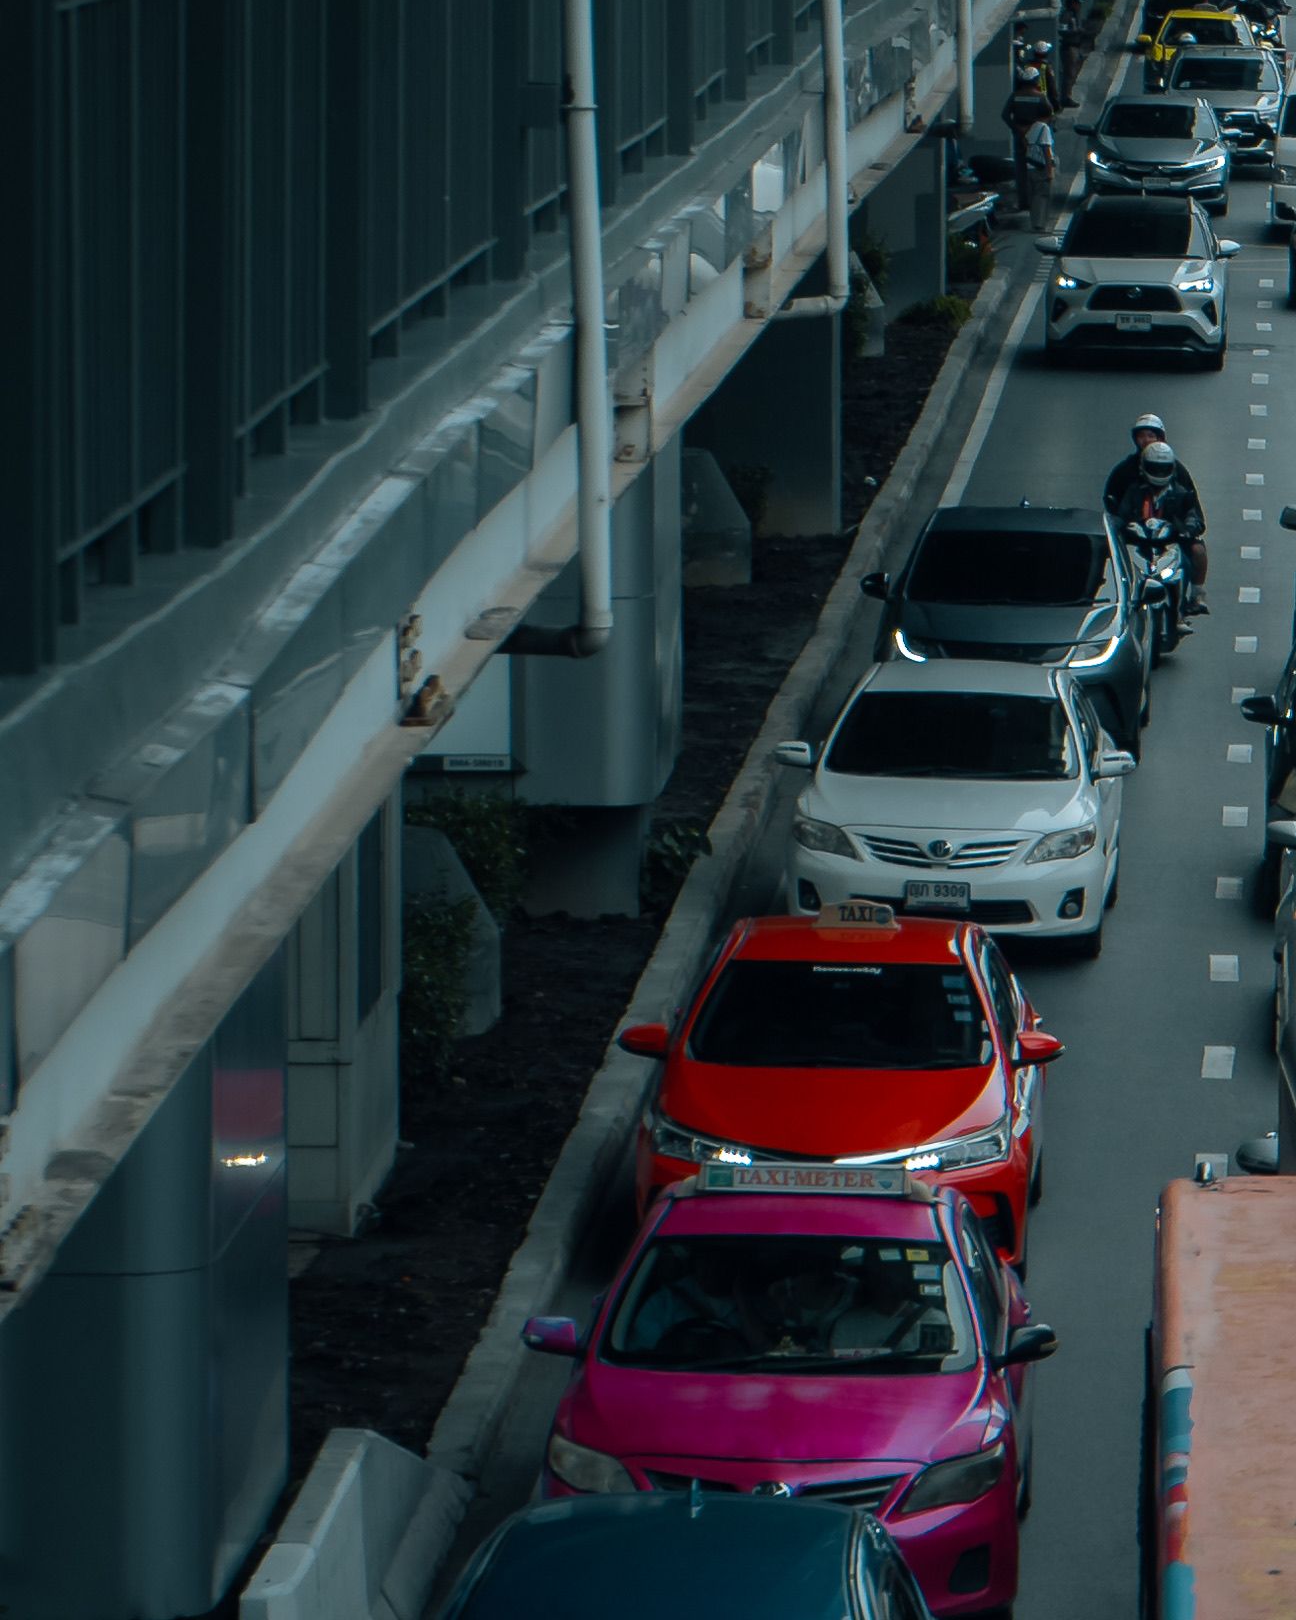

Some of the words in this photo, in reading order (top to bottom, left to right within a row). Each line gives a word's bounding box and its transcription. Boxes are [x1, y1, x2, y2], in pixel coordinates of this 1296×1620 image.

[934, 884, 966, 898] 9309
[838, 905, 874, 922] TAXI
[735, 1168, 876, 1189] TAXI-METER
